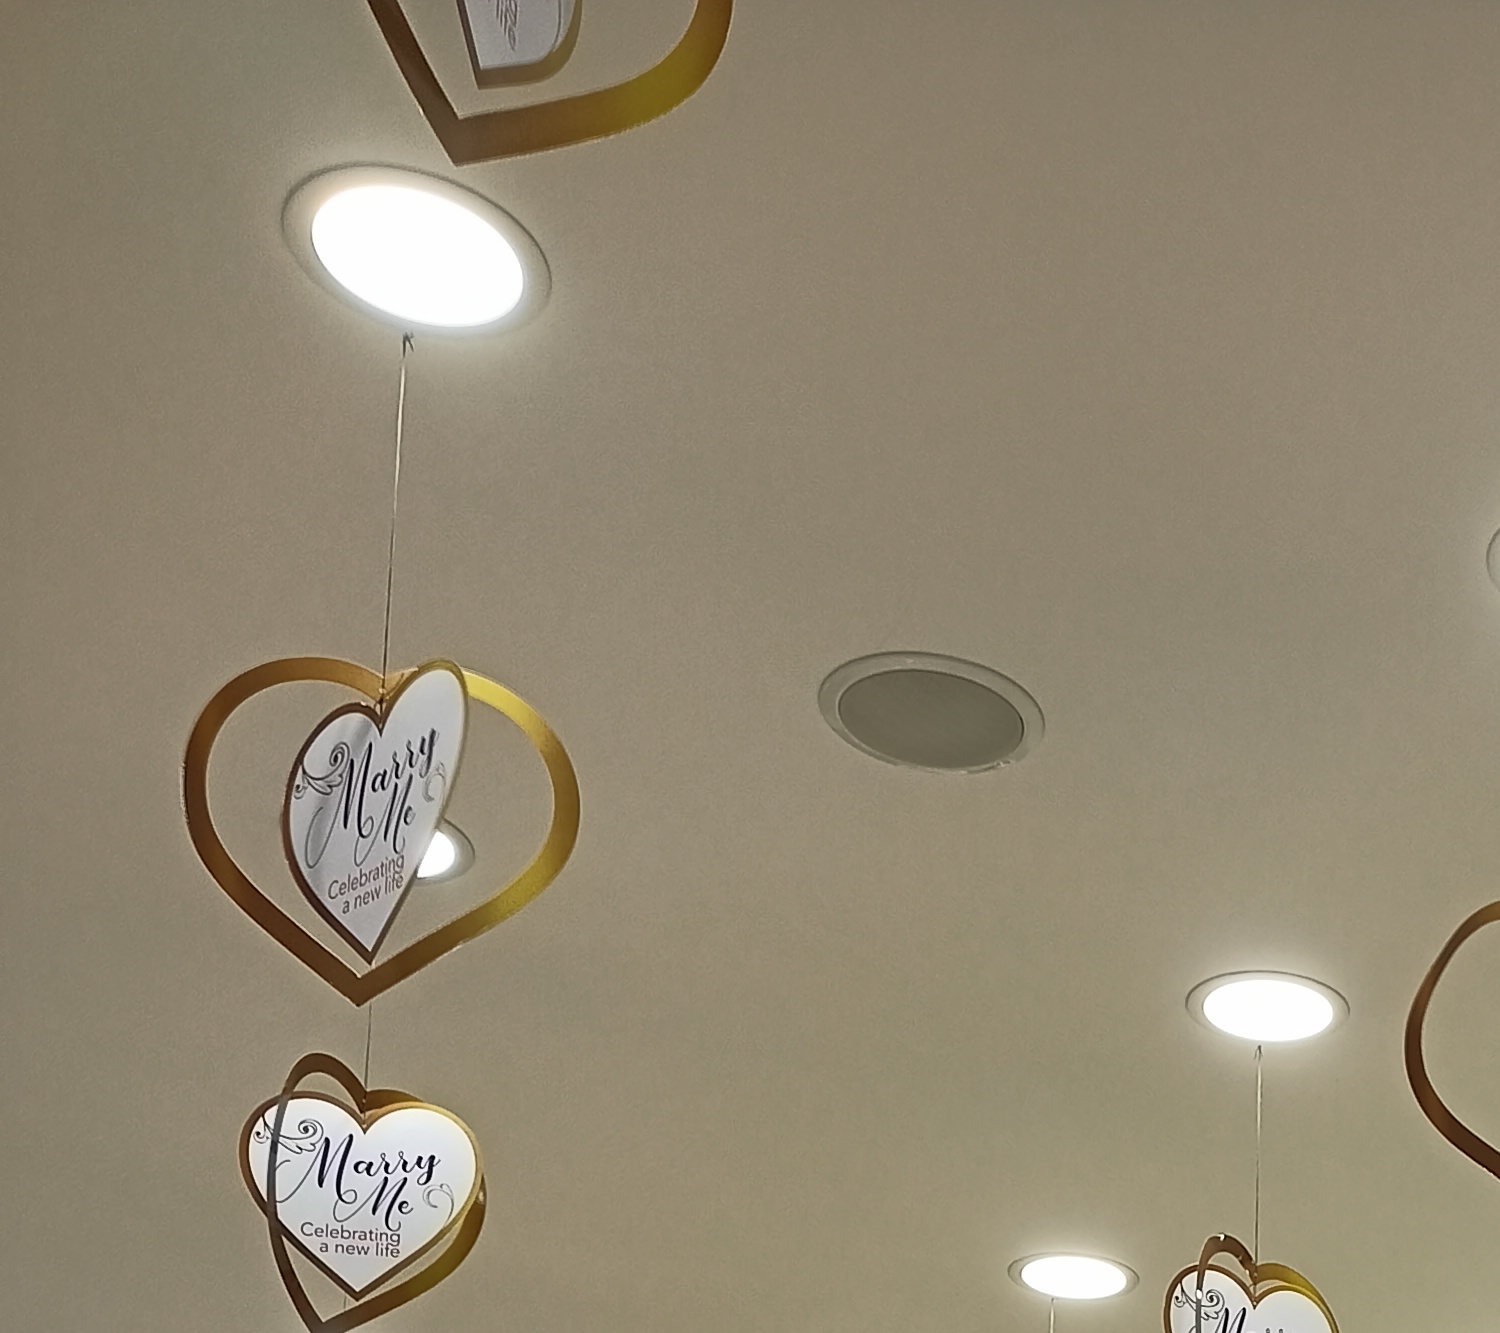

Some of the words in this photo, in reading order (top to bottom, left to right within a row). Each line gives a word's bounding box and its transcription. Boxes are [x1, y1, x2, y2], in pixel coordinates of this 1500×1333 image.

[306, 728, 440, 869] Marry
[354, 775, 416, 866] Me
[327, 853, 405, 901] Celebrating
[341, 901, 352, 915] a
[353, 886, 382, 909] new
[384, 873, 405, 896] life
[275, 1133, 441, 1204] Marry
[333, 1176, 414, 1232] Me
[300, 1221, 401, 1247] Celebrating
[319, 1242, 328, 1253] a
[335, 1243, 370, 1256] new
[375, 1242, 400, 1258] life
